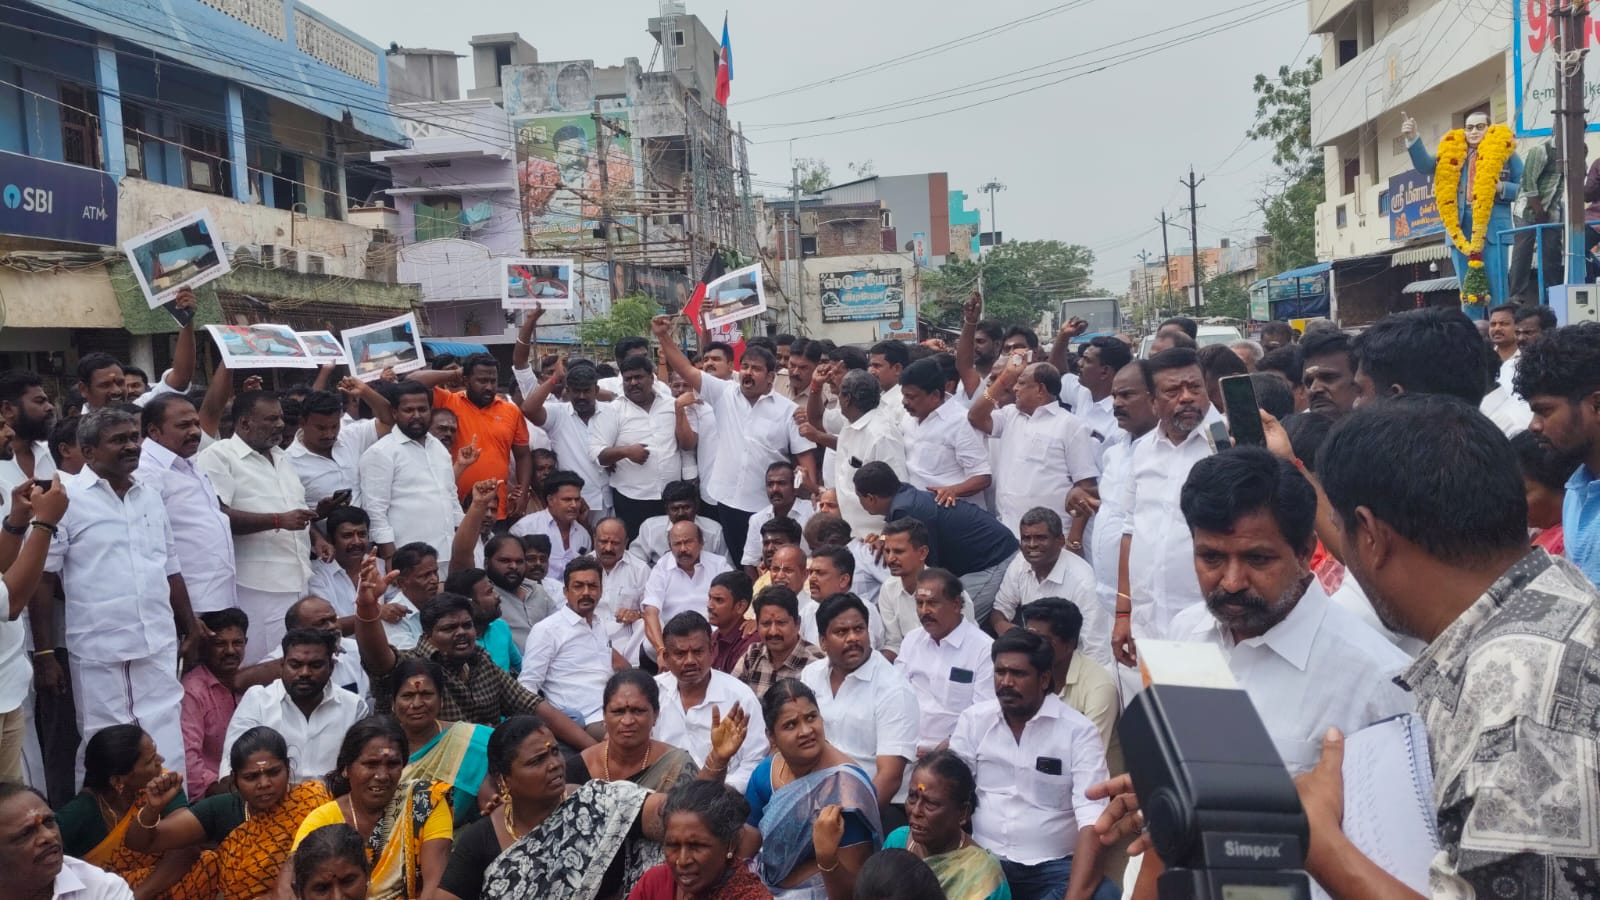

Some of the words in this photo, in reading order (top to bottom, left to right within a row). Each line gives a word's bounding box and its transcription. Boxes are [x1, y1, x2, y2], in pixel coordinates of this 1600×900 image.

[23, 187, 53, 214] SBI
[82, 205, 107, 221] ATM
[1224, 840, 1281, 861] Simpex
